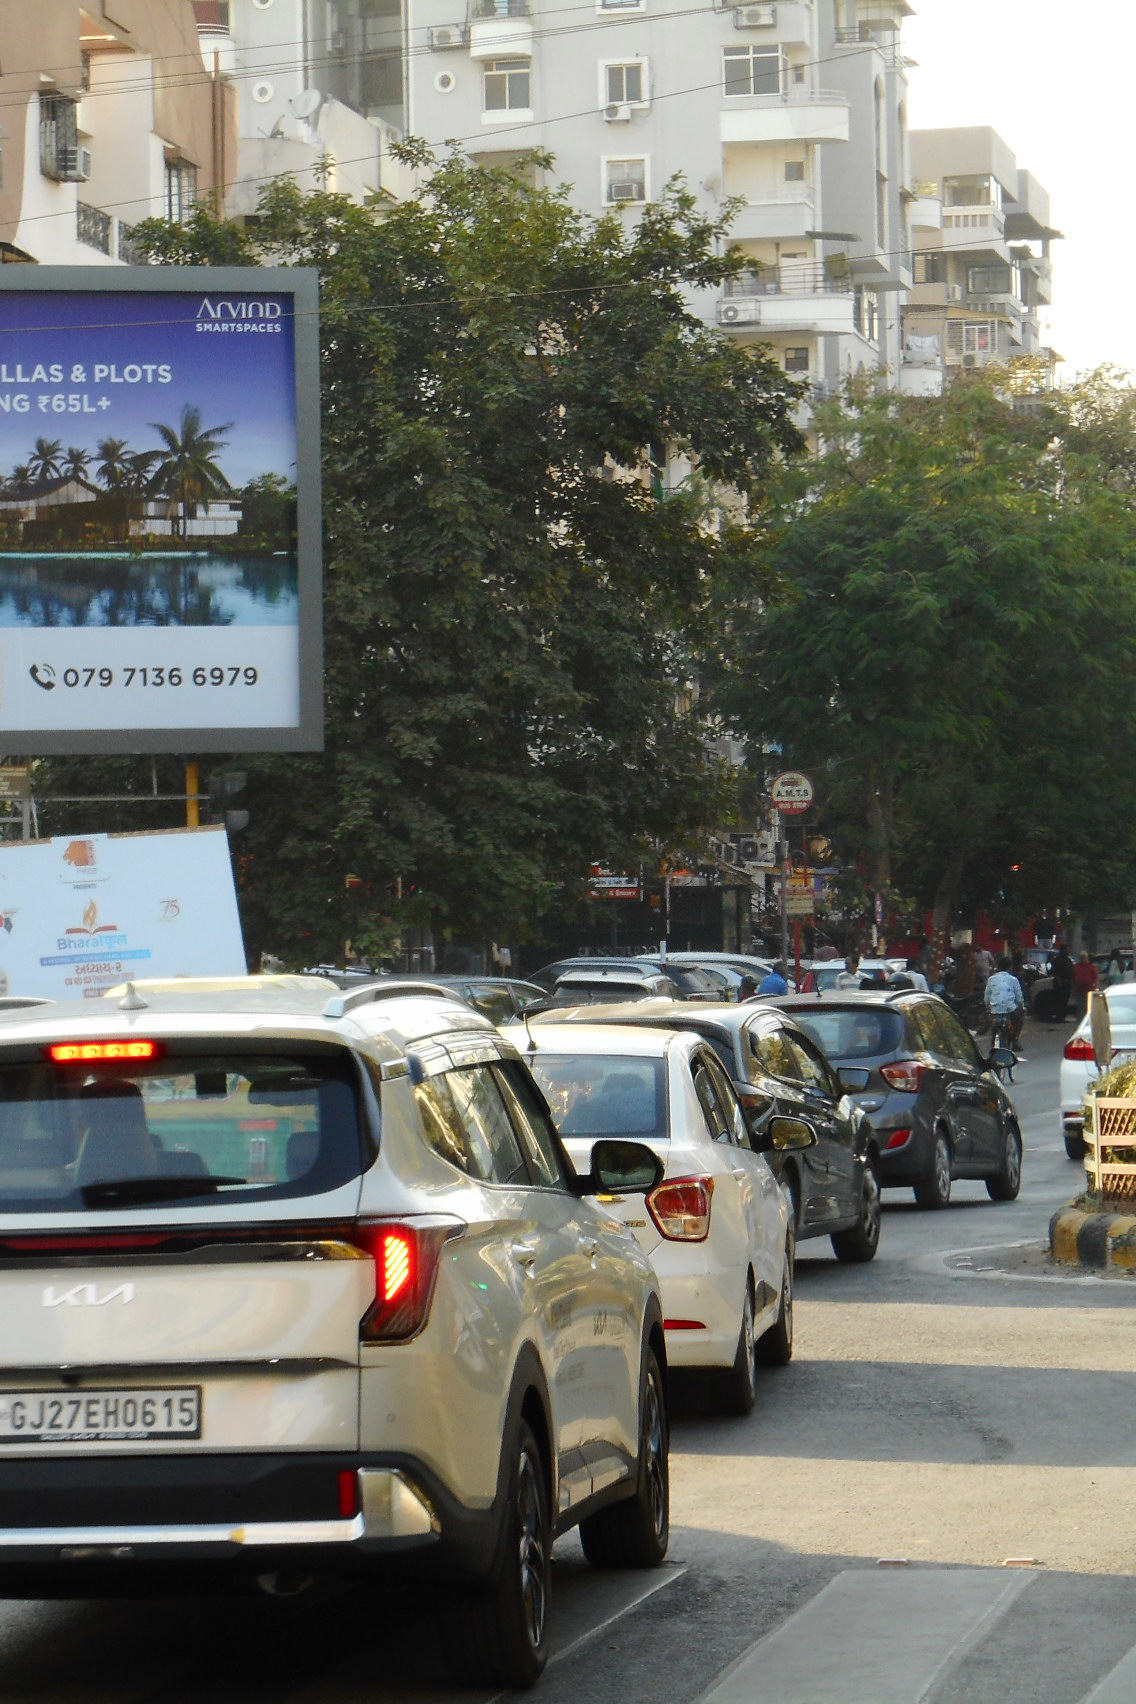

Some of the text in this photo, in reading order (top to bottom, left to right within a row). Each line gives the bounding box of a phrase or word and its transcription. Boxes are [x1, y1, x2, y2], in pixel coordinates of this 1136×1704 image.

[195, 323, 282, 333] SMARTSPACES
[70, 364, 87, 383] &
[93, 364, 172, 384] PLOTS
[37, 394, 112, 413] ₹65L+
[63, 666, 258, 688] 079 7136 6979
[10, 1397, 195, 1430] GJ27EH0615
